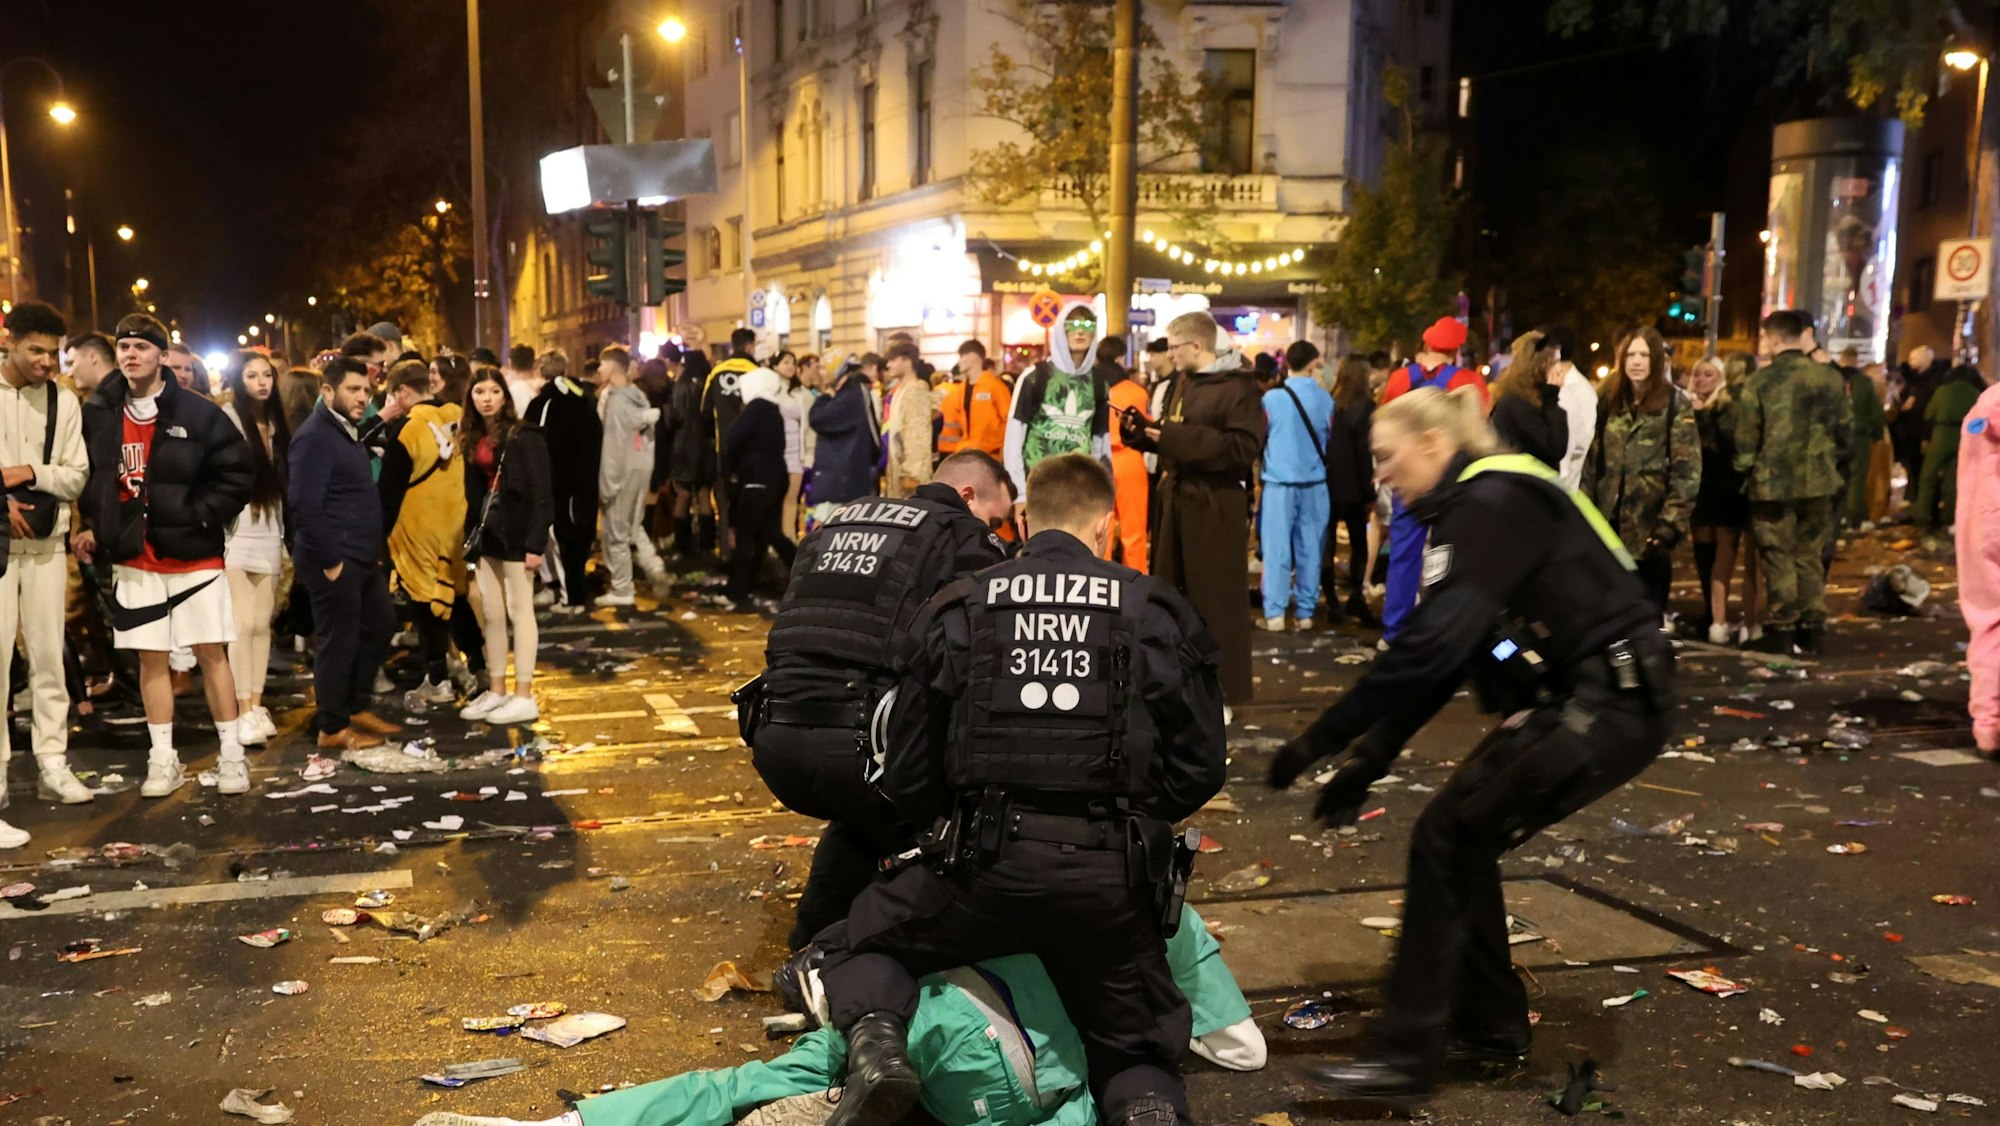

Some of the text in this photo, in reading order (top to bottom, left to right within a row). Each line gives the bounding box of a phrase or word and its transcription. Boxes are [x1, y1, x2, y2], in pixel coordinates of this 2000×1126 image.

[825, 503, 928, 526] POLIZEI
[828, 532, 887, 553] NRW
[818, 551, 877, 575] 31413
[987, 573, 1120, 608] POLIZEI
[1014, 613, 1091, 643] NRW
[1009, 647, 1091, 678] 31413
